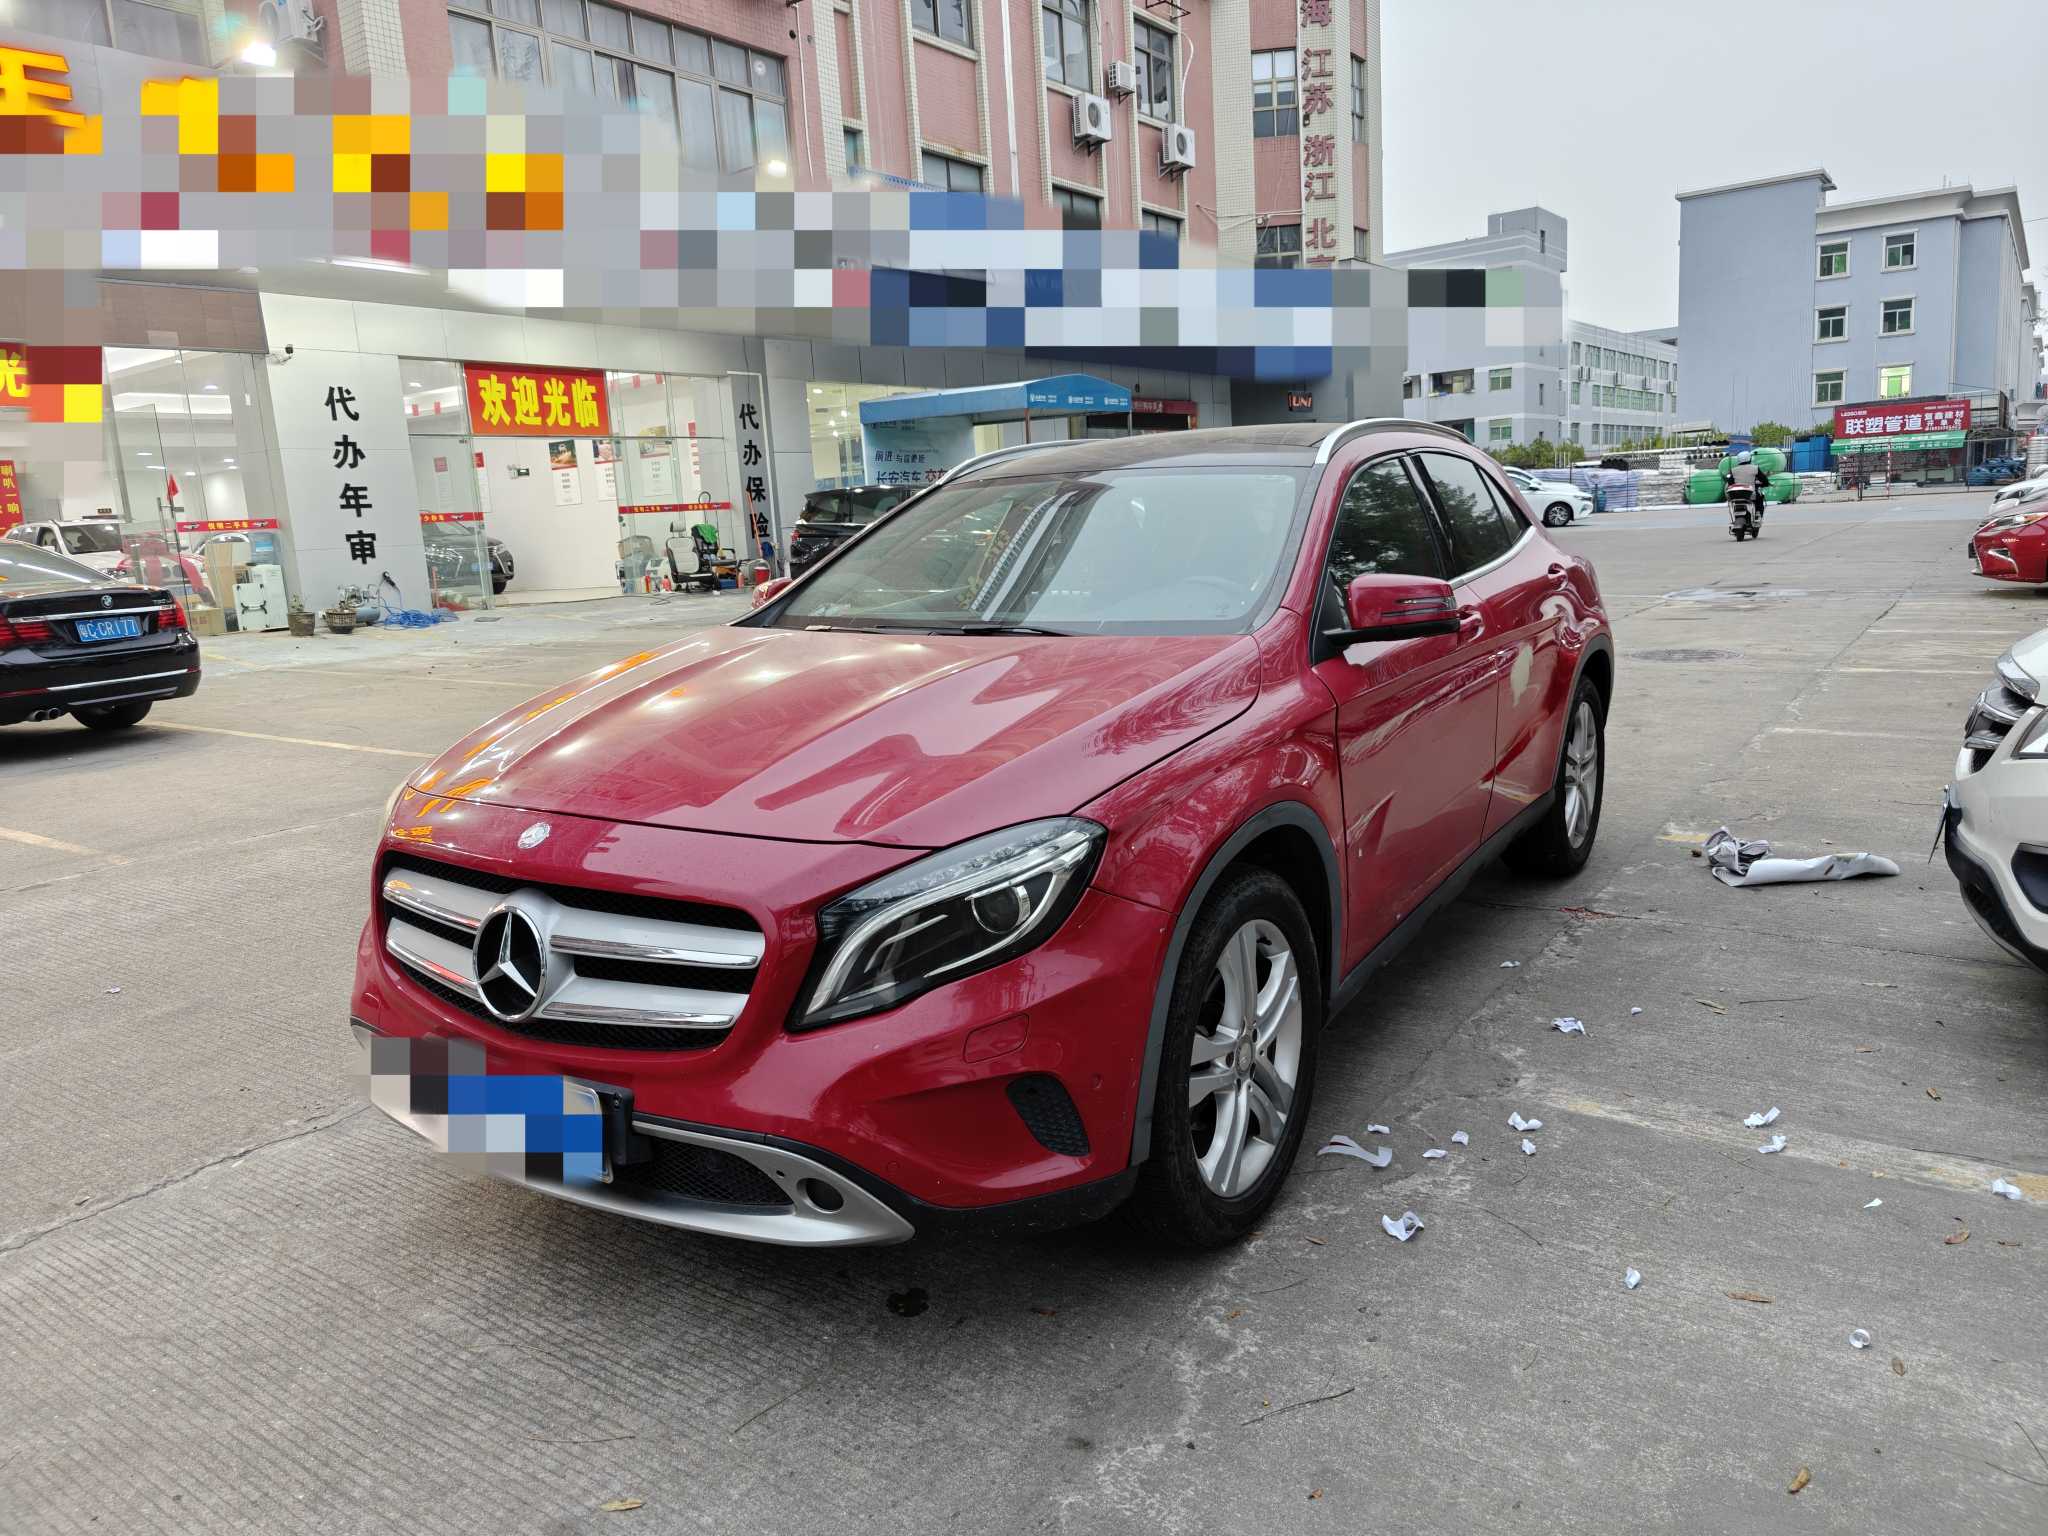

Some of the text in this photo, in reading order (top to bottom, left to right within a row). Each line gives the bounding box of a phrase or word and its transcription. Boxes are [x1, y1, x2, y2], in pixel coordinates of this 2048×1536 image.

[1302, 48, 1334, 115] 江苏
[1303, 134, 1336, 202] 浙江
[478, 373, 600, 429] 欢迎光临
[1845, 414, 1923, 435] 联塑管道
[1, 464, 21, 529] 喇叭一响
[324, 386, 377, 564] 代办年审
[738, 403, 772, 540] 代办保险
[877, 470, 922, 484] 长安汽车
